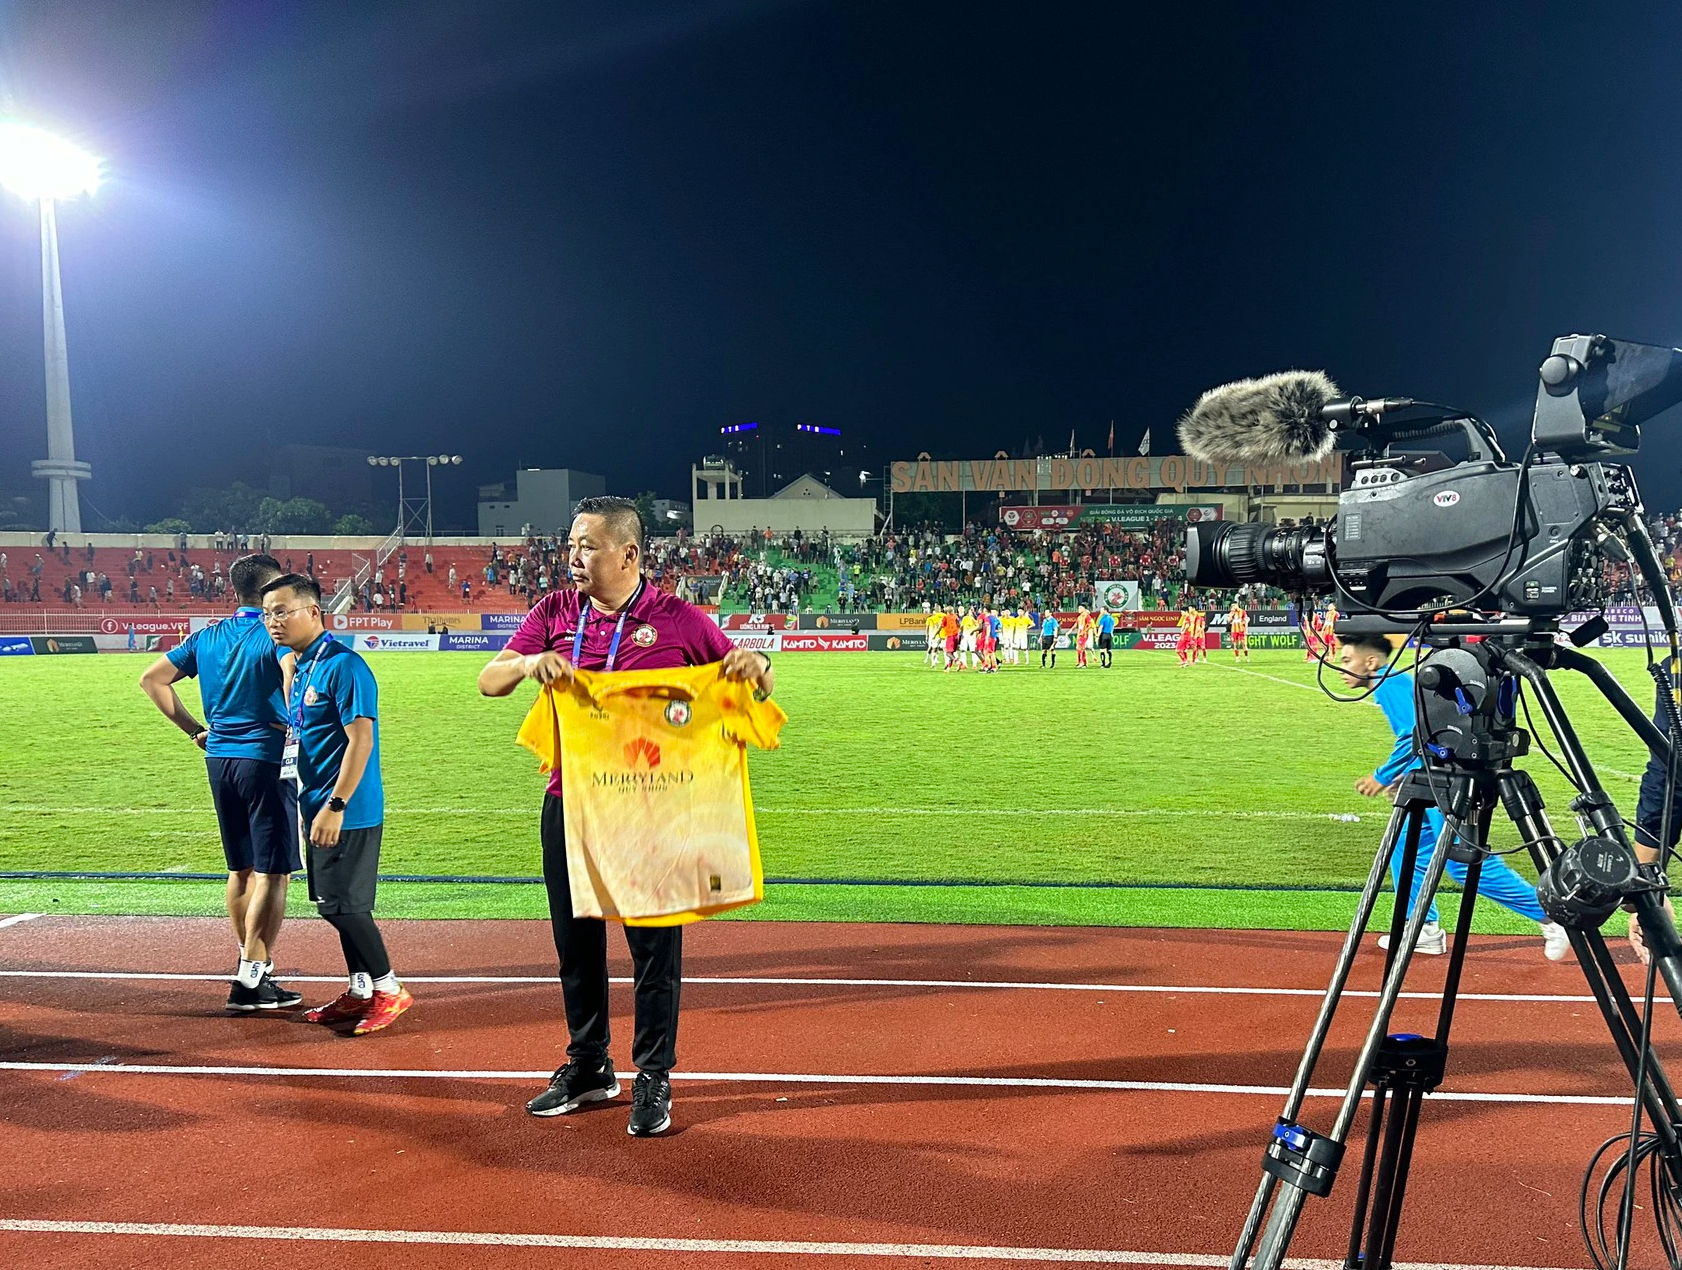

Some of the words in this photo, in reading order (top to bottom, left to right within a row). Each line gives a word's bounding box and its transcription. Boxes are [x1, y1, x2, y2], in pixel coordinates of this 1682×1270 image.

[891, 451, 960, 492] SÂN
[1160, 456, 1229, 493] QUY
[1436, 494, 1457, 503] VTV8
[349, 617, 371, 627] FPT
[372, 617, 393, 628] Play
[380, 639, 429, 647] Vietravel
[449, 636, 488, 644] MARINA
[783, 640, 817, 648] KAMITO
[832, 640, 866, 648] KAMITO
[1270, 635, 1297, 647] WOLF
[592, 770, 694, 787] MERRYLAND
